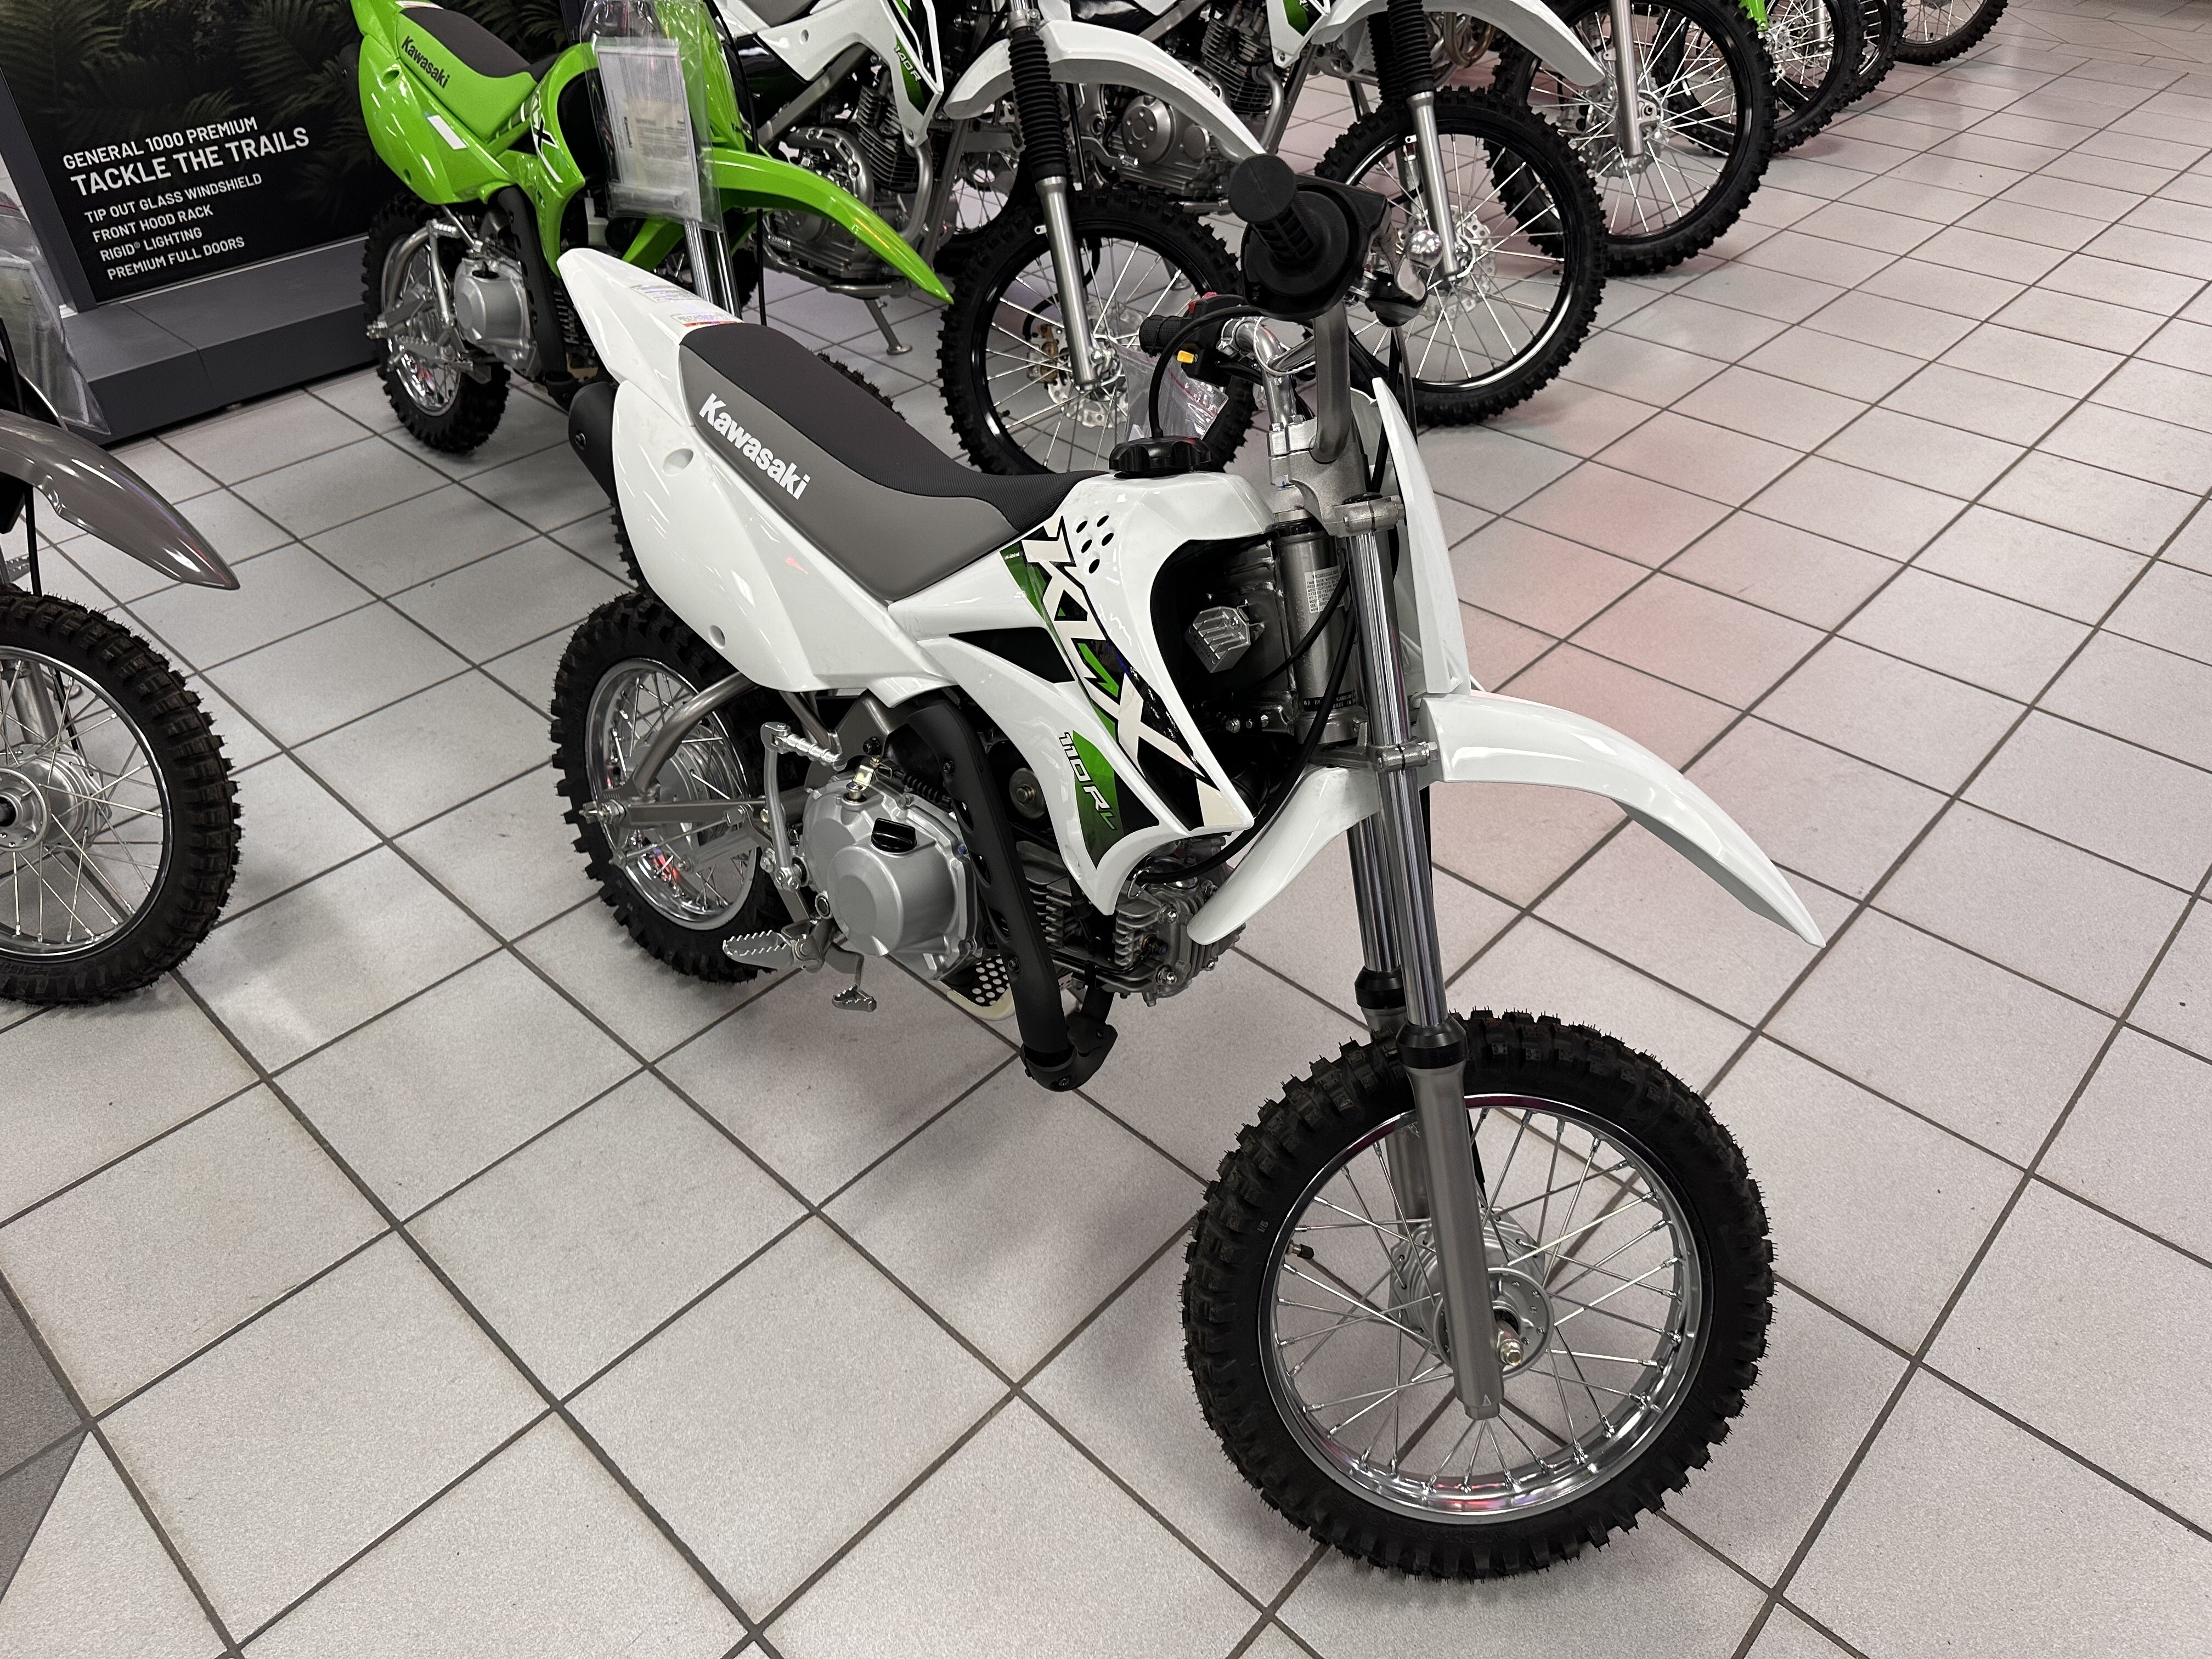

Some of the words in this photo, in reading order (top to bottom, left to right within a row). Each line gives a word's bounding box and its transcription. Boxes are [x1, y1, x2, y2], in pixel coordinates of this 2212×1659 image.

[401, 35, 450, 89] Kawasaki
[63, 141, 145, 170] GENERAL
[145, 132, 184, 152] 1000
[185, 116, 258, 144] PREMIUM
[70, 156, 172, 196] TACKLE
[172, 145, 224, 173] THE
[224, 127, 309, 162] TRAILS
[84, 208, 106, 223] TIP
[109, 201, 136, 218] OUT
[139, 191, 184, 211] GLASS
[184, 173, 262, 200] WINDSHIELD
[92, 222, 136, 243] FRONT
[139, 213, 176, 232] HOOD
[177, 204, 214, 223] RACK
[107, 255, 167, 281] PREMIUM
[167, 247, 202, 266] FULL
[202, 235, 245, 257] DOORS
[143, 227, 203, 251] LIGHTING
[699, 392, 811, 500] Kawasaki
[1021, 516, 1206, 780] KLX
